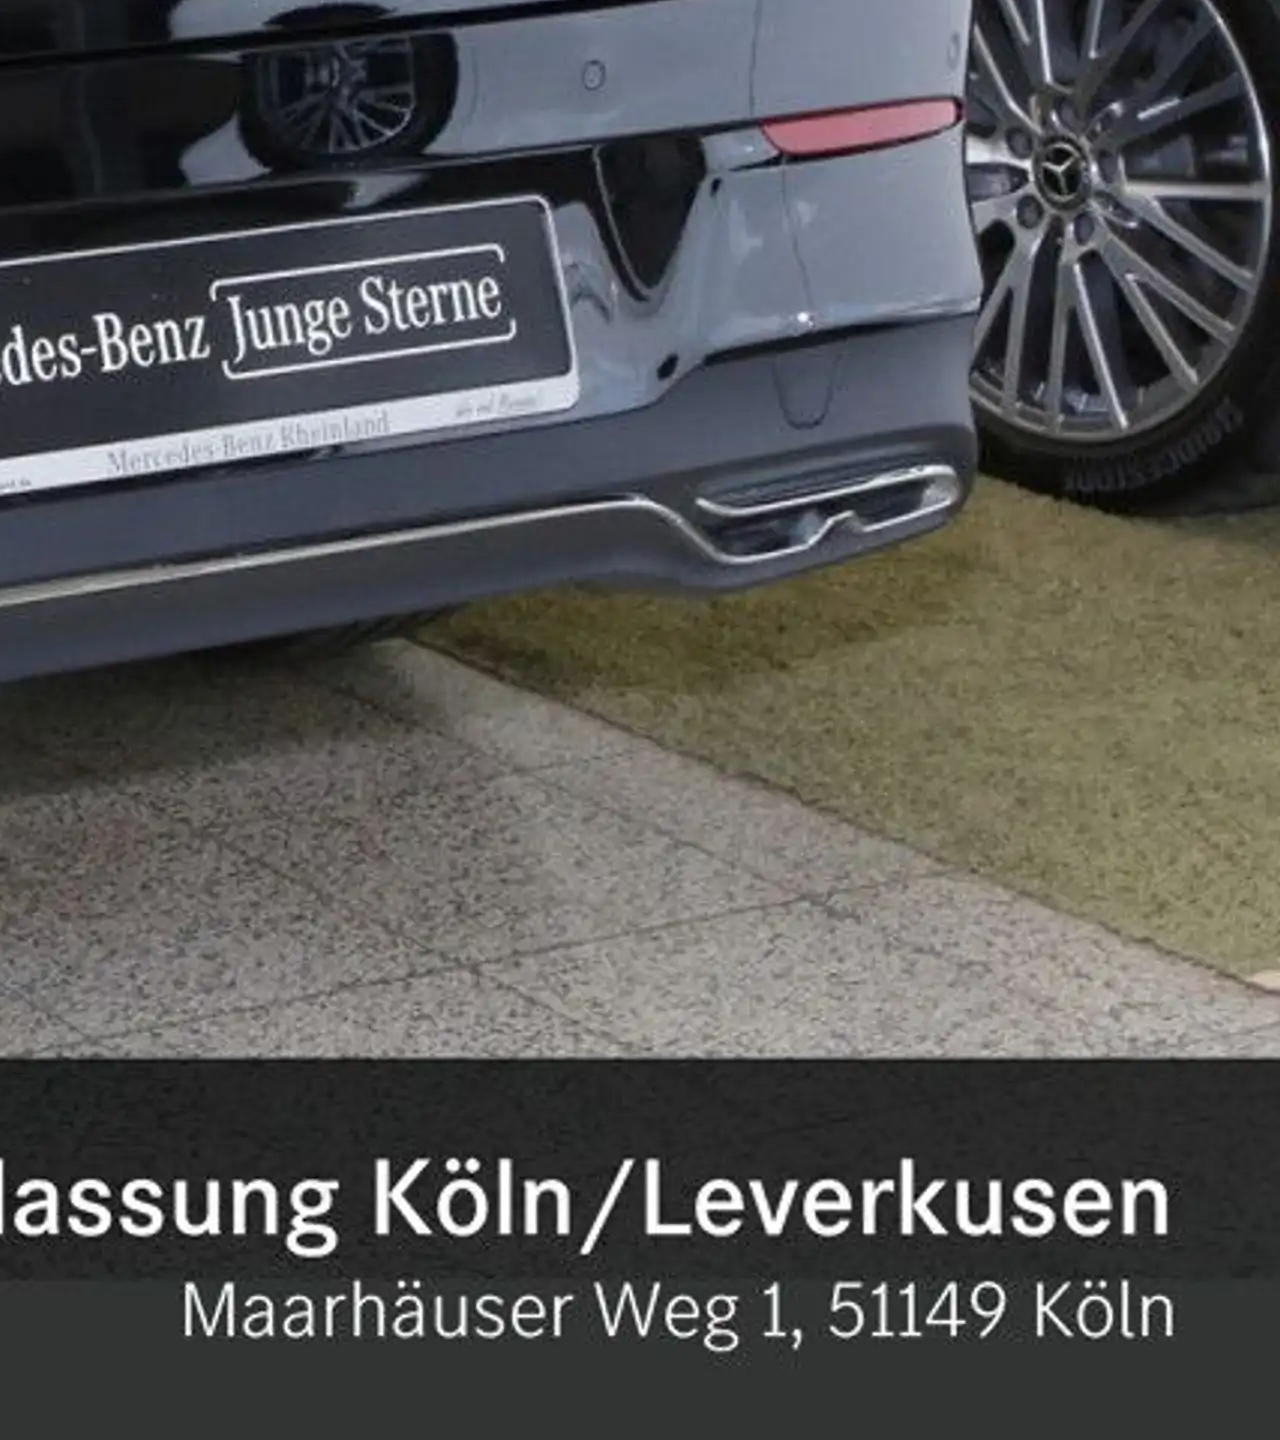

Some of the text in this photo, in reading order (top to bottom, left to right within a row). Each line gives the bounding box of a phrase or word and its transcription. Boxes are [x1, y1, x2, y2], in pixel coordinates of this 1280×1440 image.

[228, 295, 352, 364] Junge
[359, 276, 502, 334] Sterne
[281, 410, 390, 448] Rheinland
